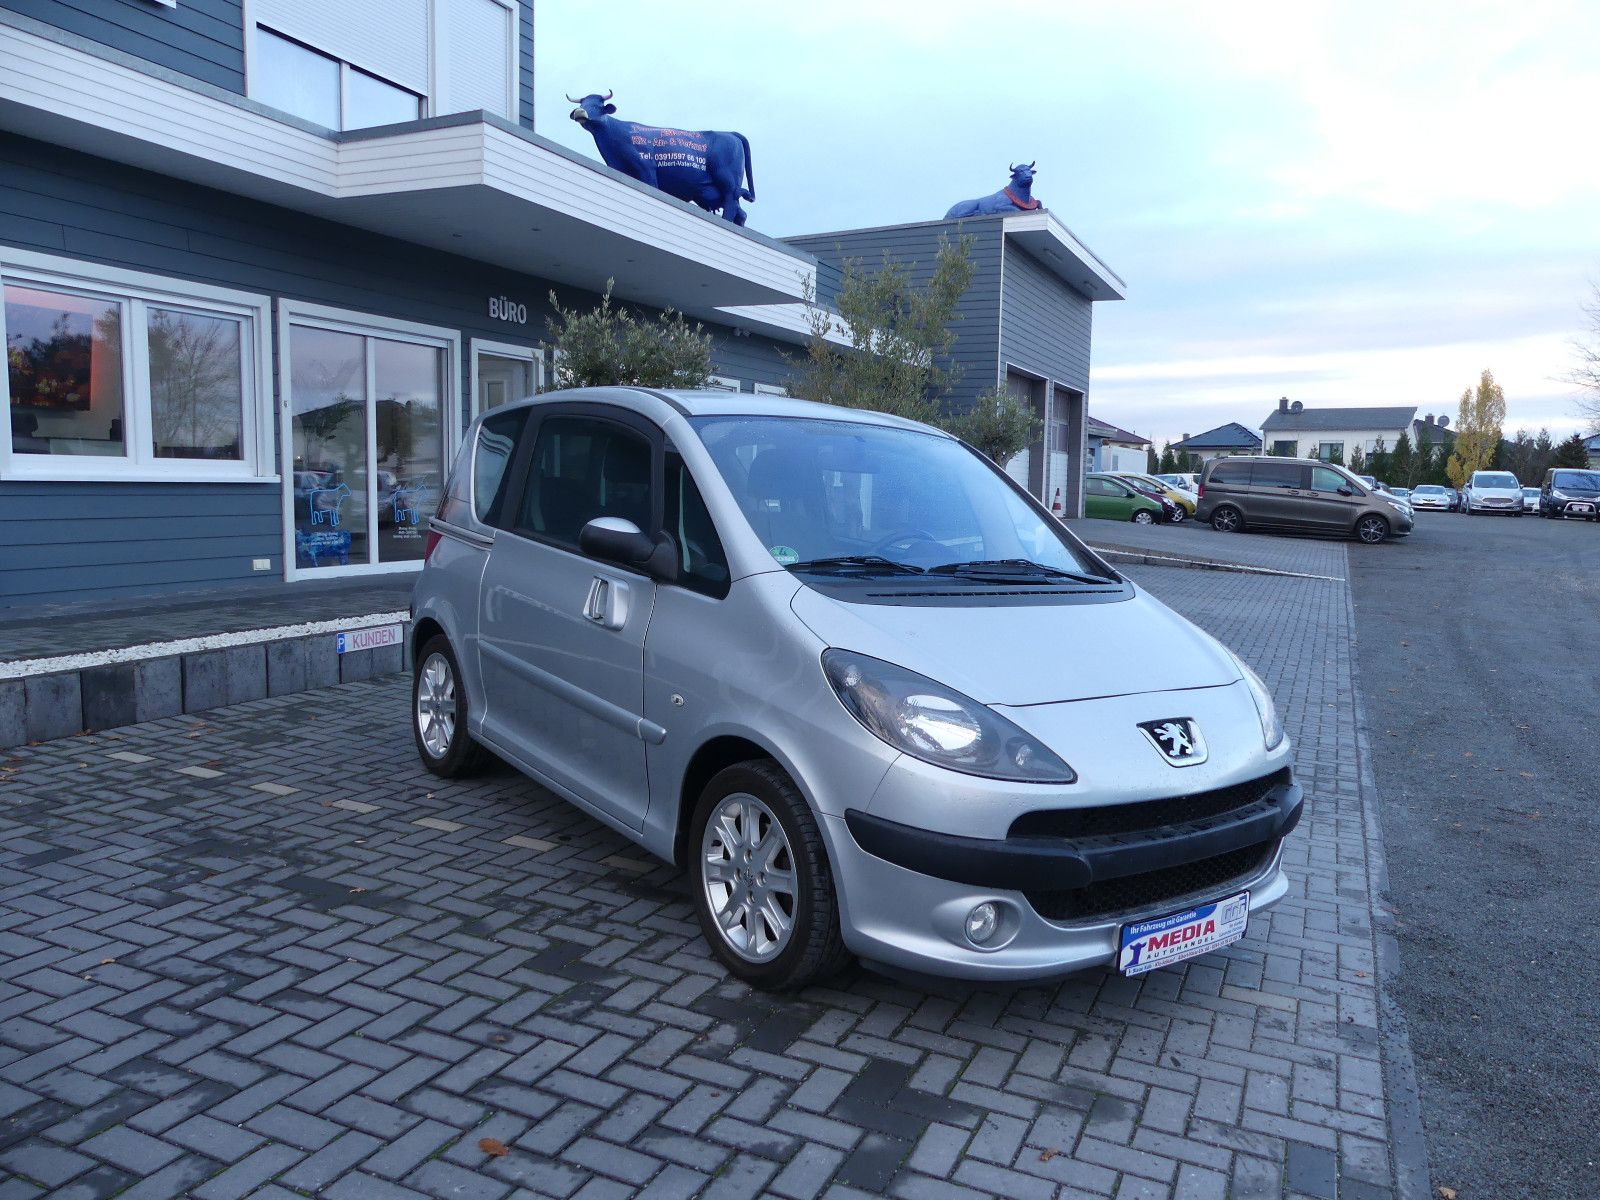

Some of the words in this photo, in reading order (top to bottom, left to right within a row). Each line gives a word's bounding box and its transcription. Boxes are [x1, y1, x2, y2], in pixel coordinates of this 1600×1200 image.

[639, 152, 653, 160] Tel.
[654, 153, 686, 161] 0391/597
[696, 156, 706, 165] 100
[489, 296, 527, 324] BÜRO
[352, 628, 396, 649] KUNDEN
[1130, 926, 1140, 935] Ihr
[1140, 921, 1167, 933] Fahrzeug
[1166, 917, 1176, 926] mit
[1175, 911, 1197, 923] Garantie
[1146, 935, 1215, 960] AUTOHANDEL
[1147, 919, 1215, 952] MEDIA
